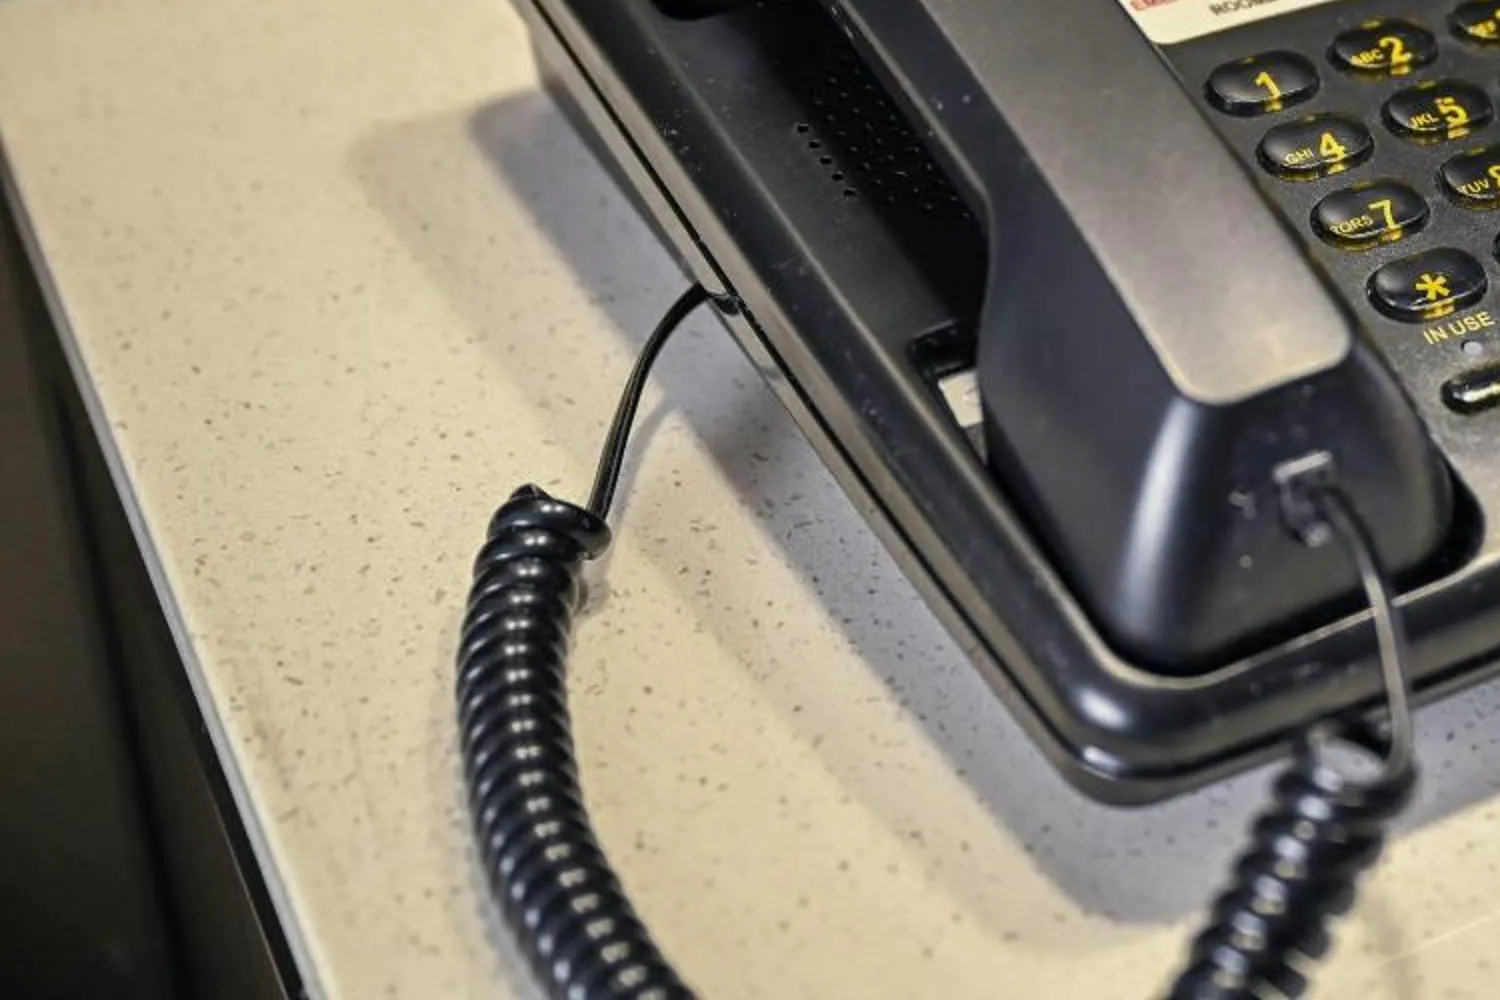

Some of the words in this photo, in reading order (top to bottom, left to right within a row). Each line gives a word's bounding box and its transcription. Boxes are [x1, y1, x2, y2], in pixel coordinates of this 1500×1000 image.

[1379, 36, 1414, 63] 2
[1254, 71, 1282, 101] 1
[1434, 96, 1472, 128] 5
[1284, 146, 1315, 166] GHI
[1319, 131, 1347, 161] 4
[1457, 177, 1491, 195] TUV
[1368, 199, 1402, 230] 7
[1423, 322, 1449, 344] IN
[1449, 311, 1495, 336] USE
